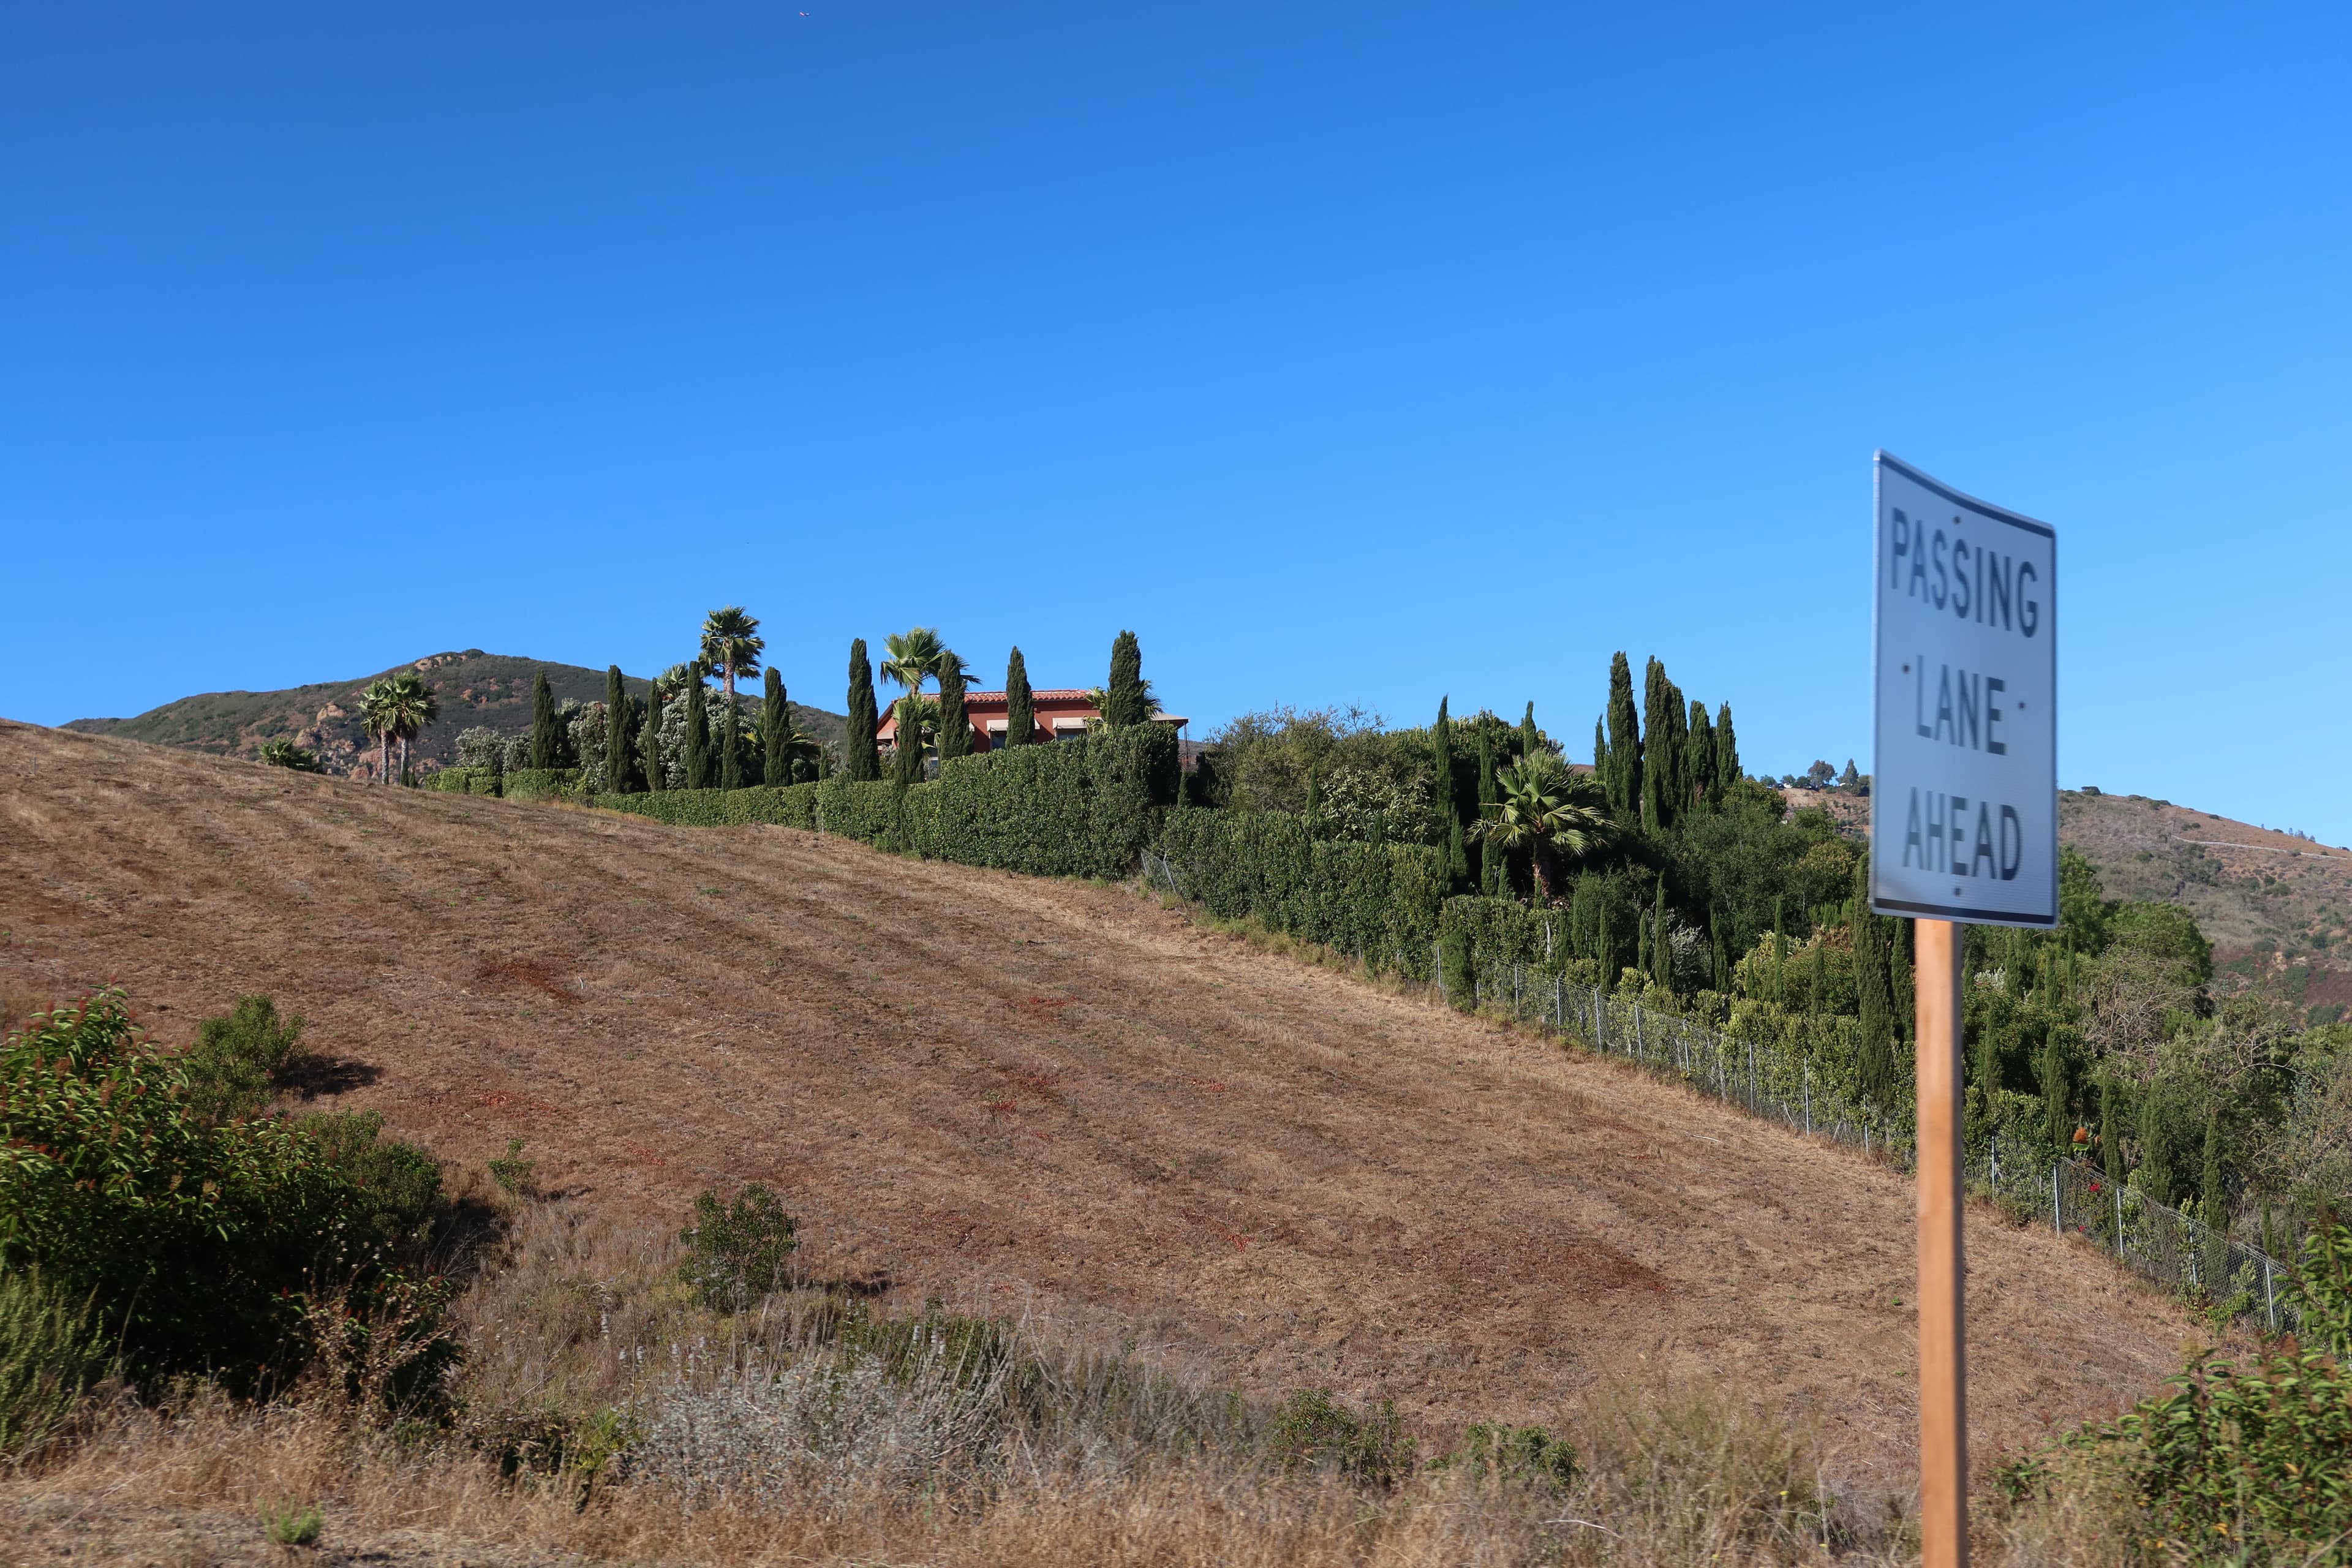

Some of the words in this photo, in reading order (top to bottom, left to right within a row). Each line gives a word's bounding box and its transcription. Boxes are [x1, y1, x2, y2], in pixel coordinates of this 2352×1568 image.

[1891, 507, 2038, 638] PASSING
[1917, 654, 2006, 756] LANE
[1902, 786, 2021, 881] AHEAD
